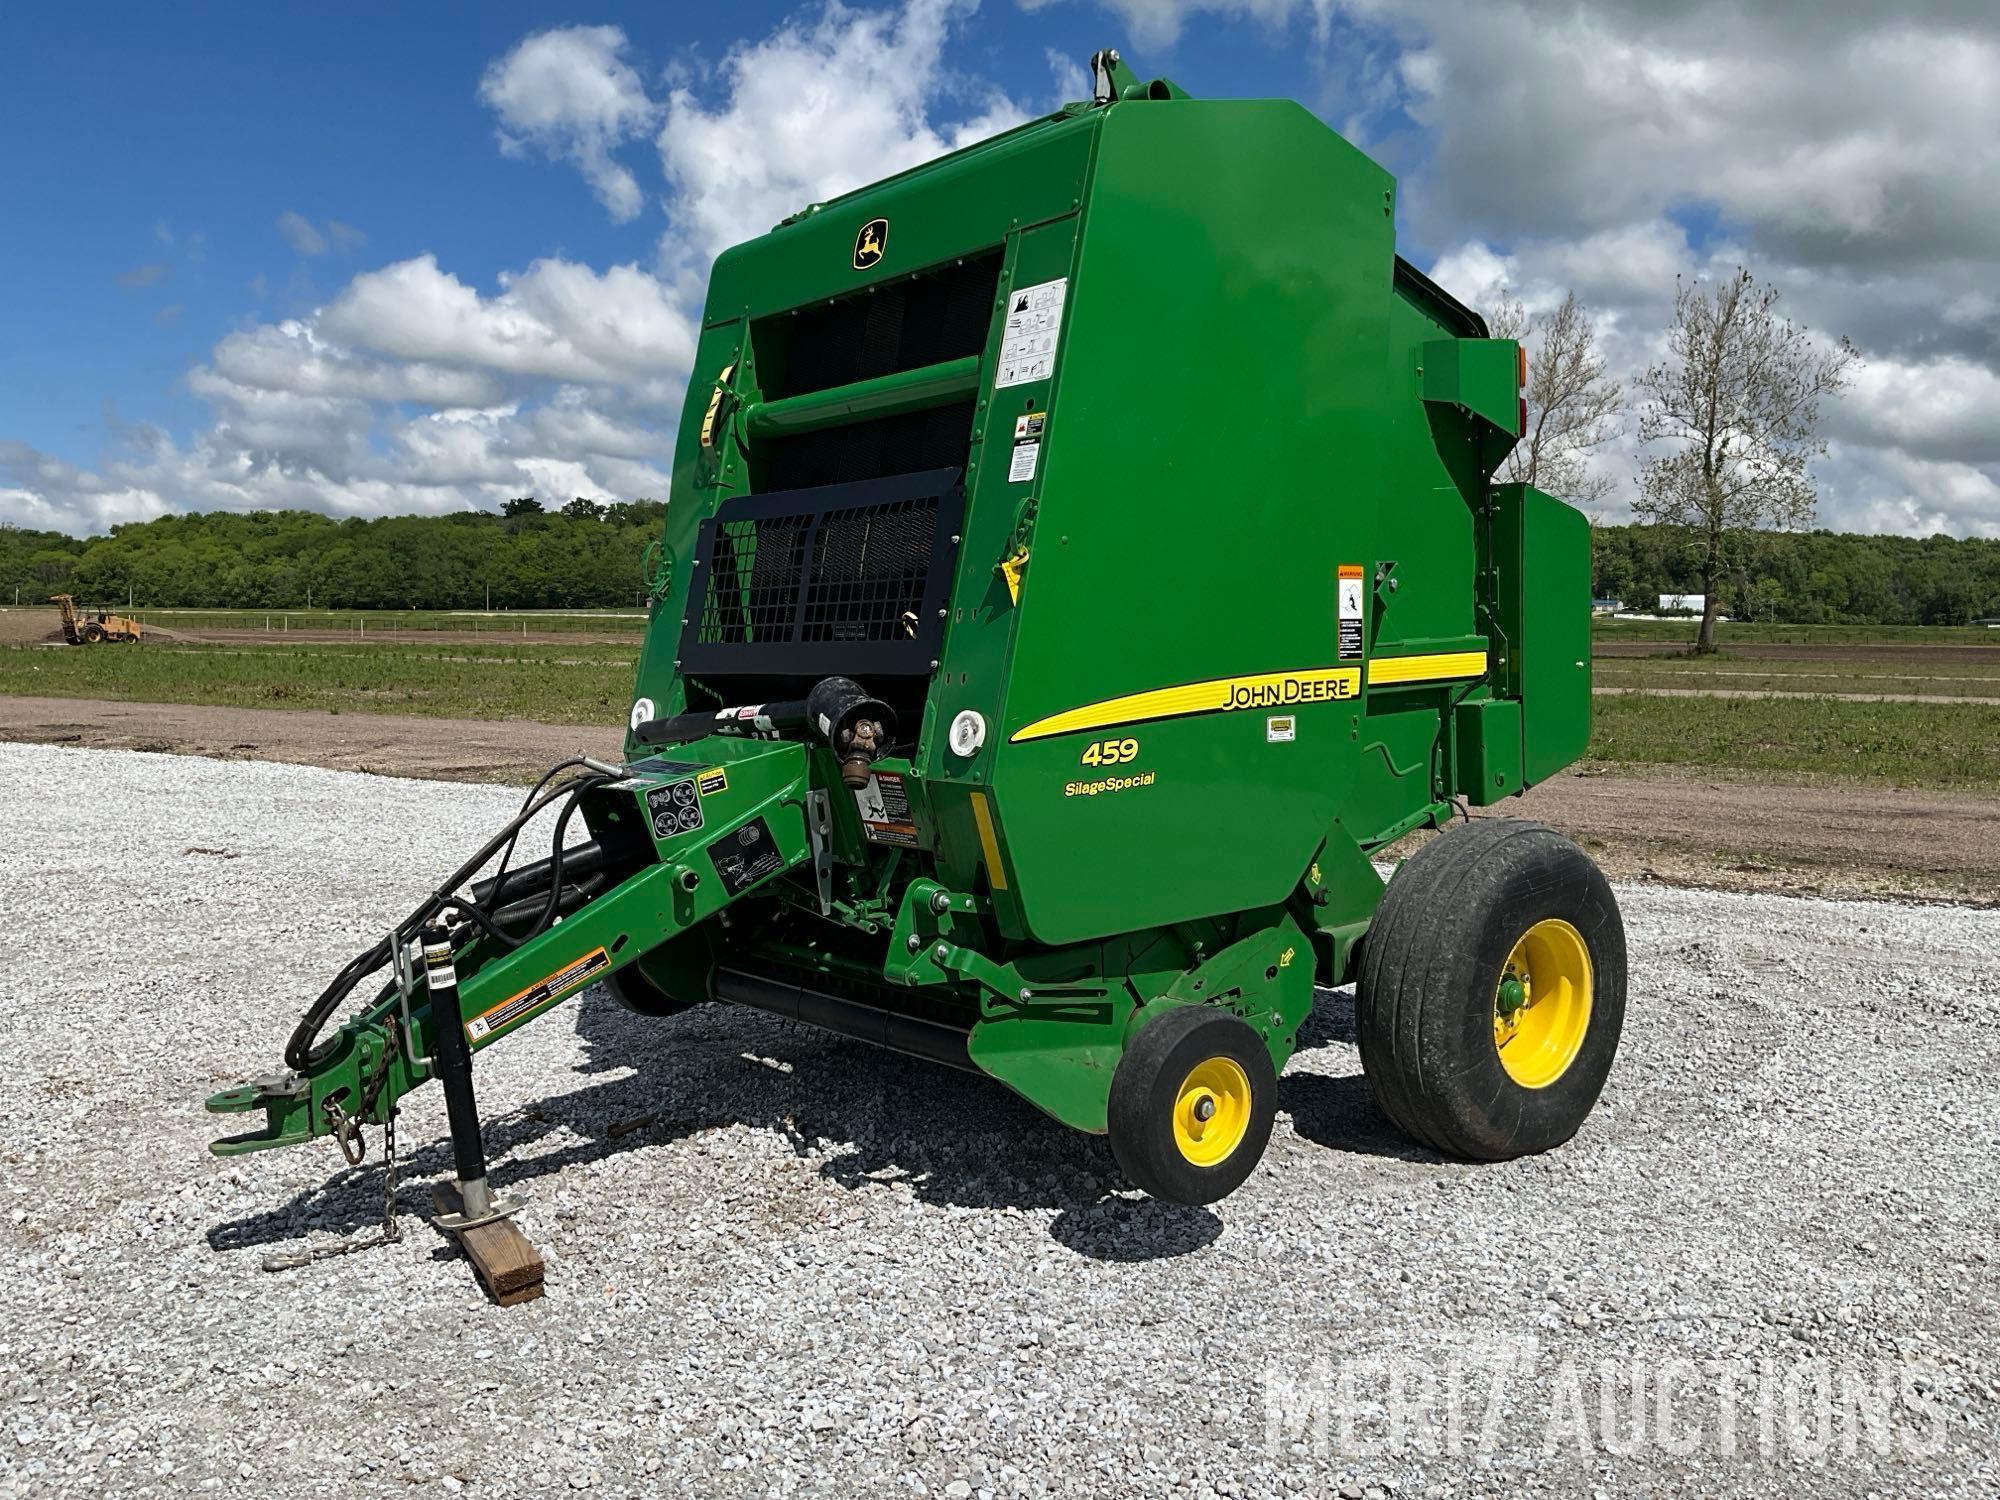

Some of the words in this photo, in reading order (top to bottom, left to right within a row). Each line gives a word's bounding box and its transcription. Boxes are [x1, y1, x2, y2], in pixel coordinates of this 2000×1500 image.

[1222, 684, 1280, 707] JOHN
[1284, 679, 1350, 701] DEERE
[1081, 738, 1139, 767] 459
[1065, 771, 1155, 796] SilageSpecial
